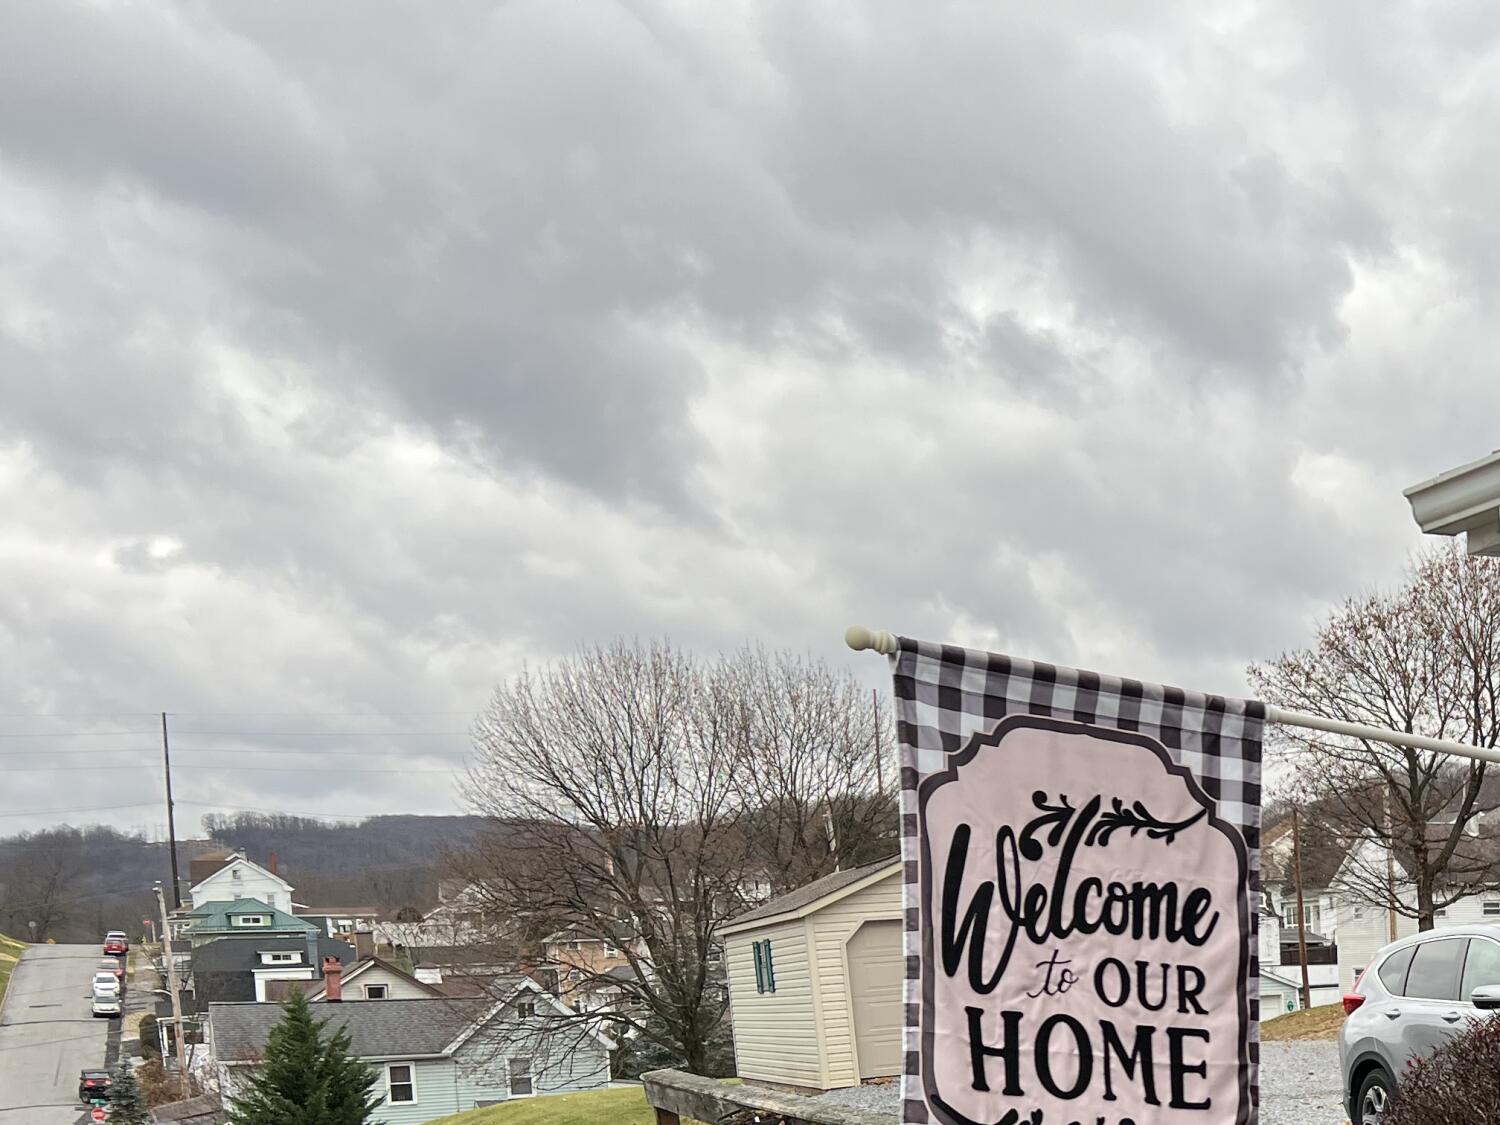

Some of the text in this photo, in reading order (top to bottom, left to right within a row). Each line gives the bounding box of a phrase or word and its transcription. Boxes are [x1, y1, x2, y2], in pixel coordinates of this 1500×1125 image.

[942, 795, 1219, 995] Welcome
[1026, 949, 1209, 1016] to OUR
[964, 1006, 1212, 1111] HOME
